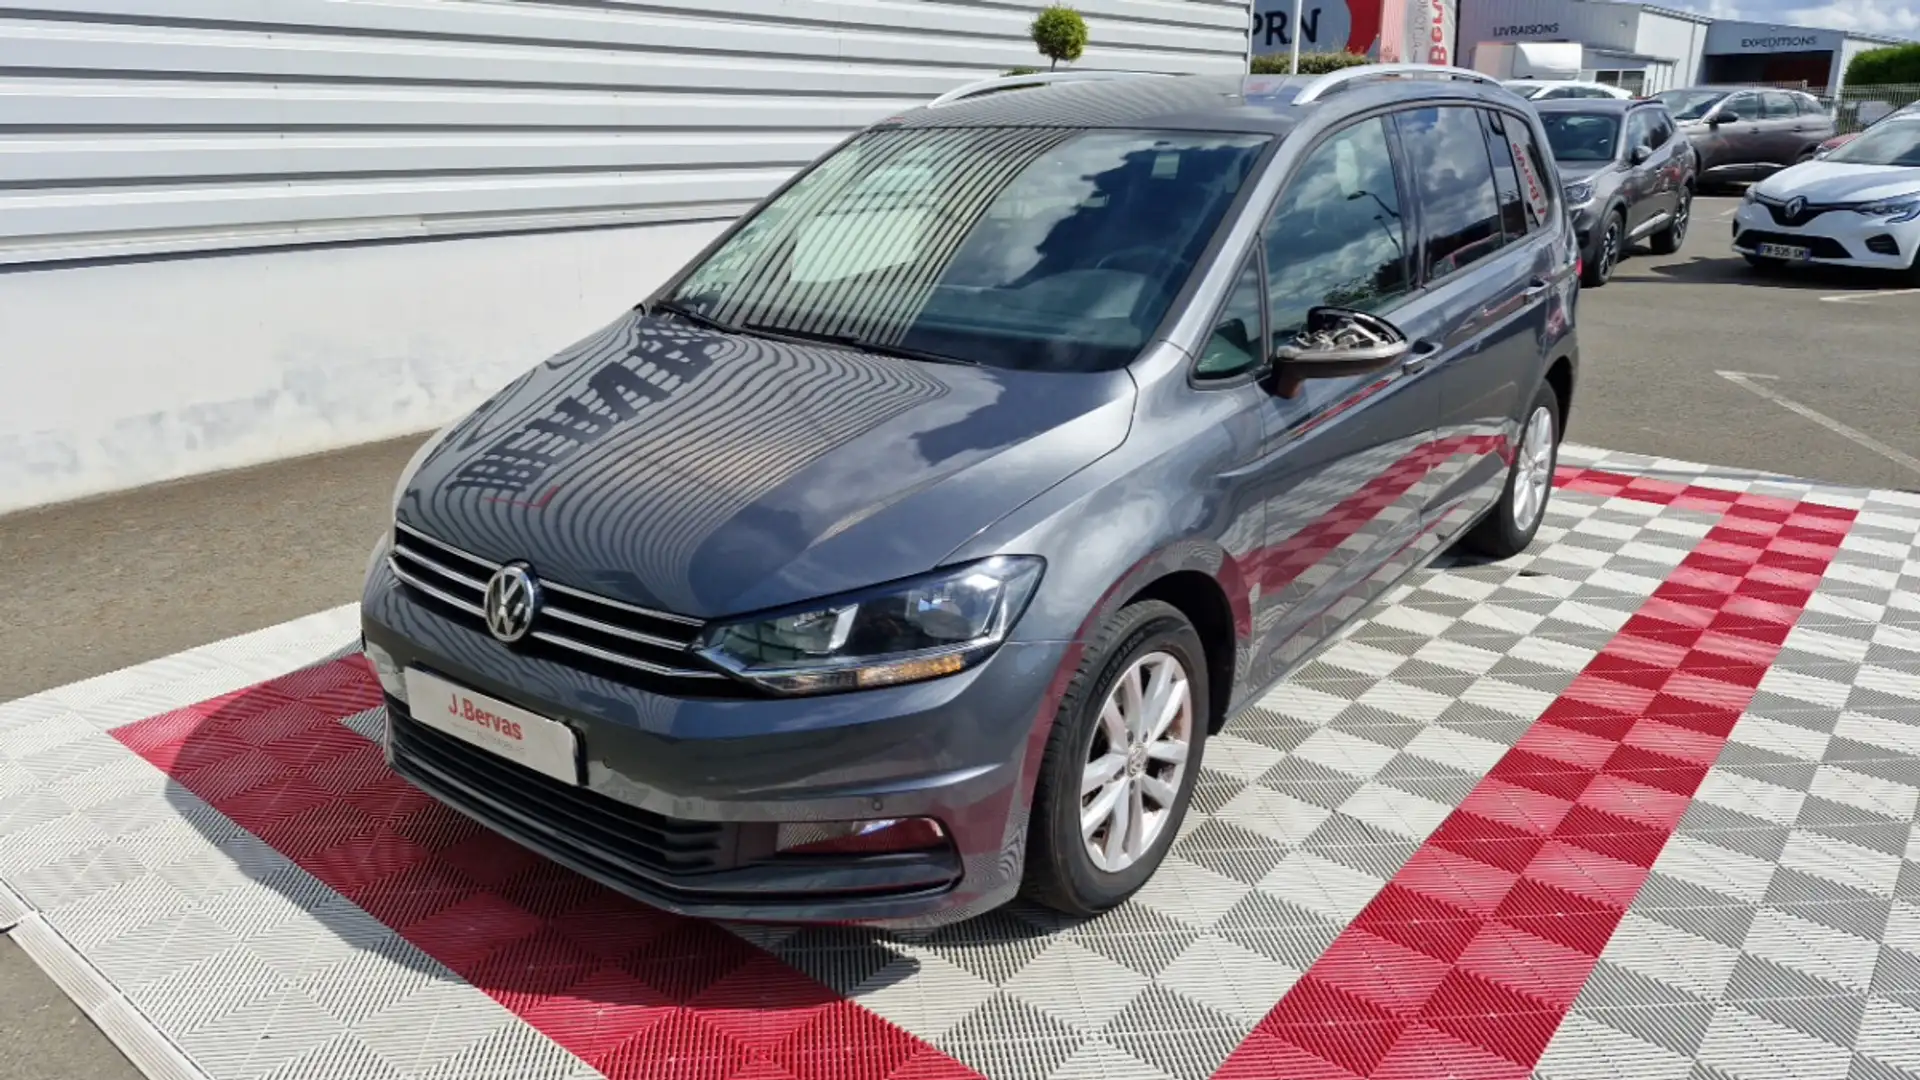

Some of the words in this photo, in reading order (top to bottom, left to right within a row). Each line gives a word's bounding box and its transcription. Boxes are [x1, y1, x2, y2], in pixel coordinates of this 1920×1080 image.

[1492, 22, 1560, 37] LIVRAISONS
[1740, 35, 1818, 48] EXPEDITIONS
[447, 692, 524, 741] J.Bervas
